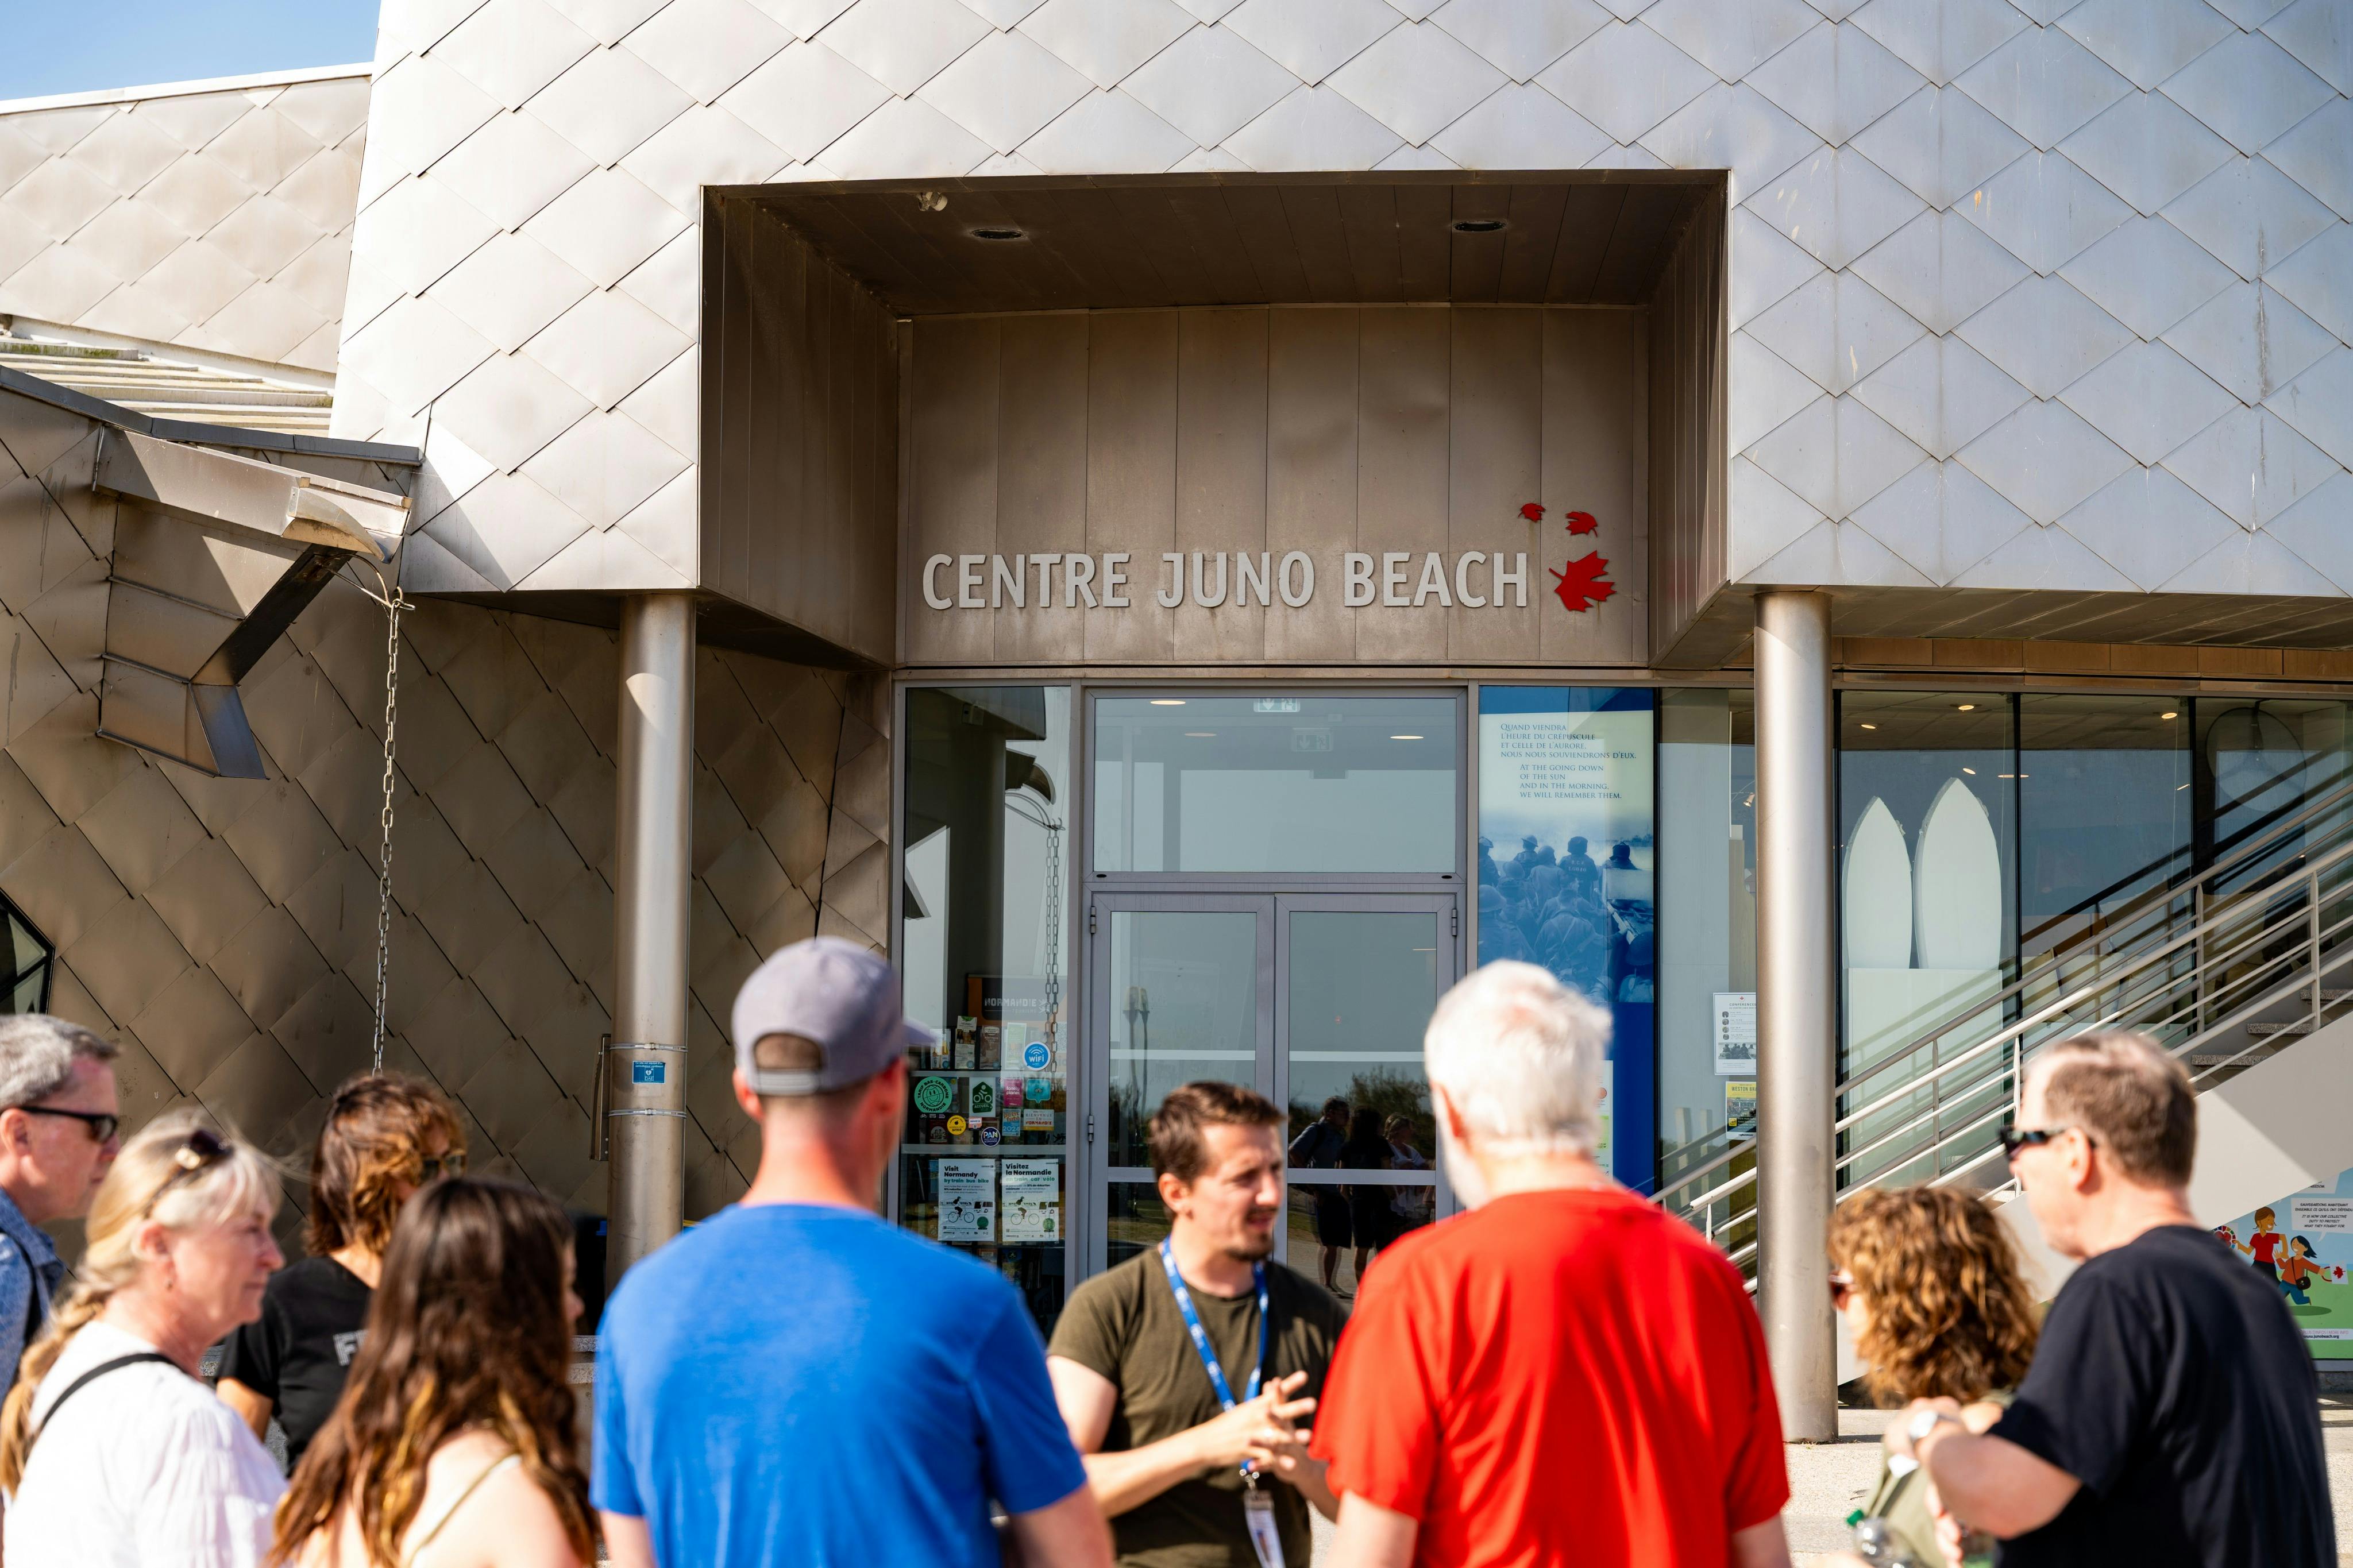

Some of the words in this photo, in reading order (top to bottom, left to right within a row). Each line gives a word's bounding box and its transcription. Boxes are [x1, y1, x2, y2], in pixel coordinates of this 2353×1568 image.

[923, 553, 1131, 610] CENTRE
[1157, 551, 1315, 609] JUNO
[1344, 551, 1527, 608] BEACH
[985, 998, 1037, 1007] NORMANDIE
[920, 1102, 947, 1111] NORMANDIE
